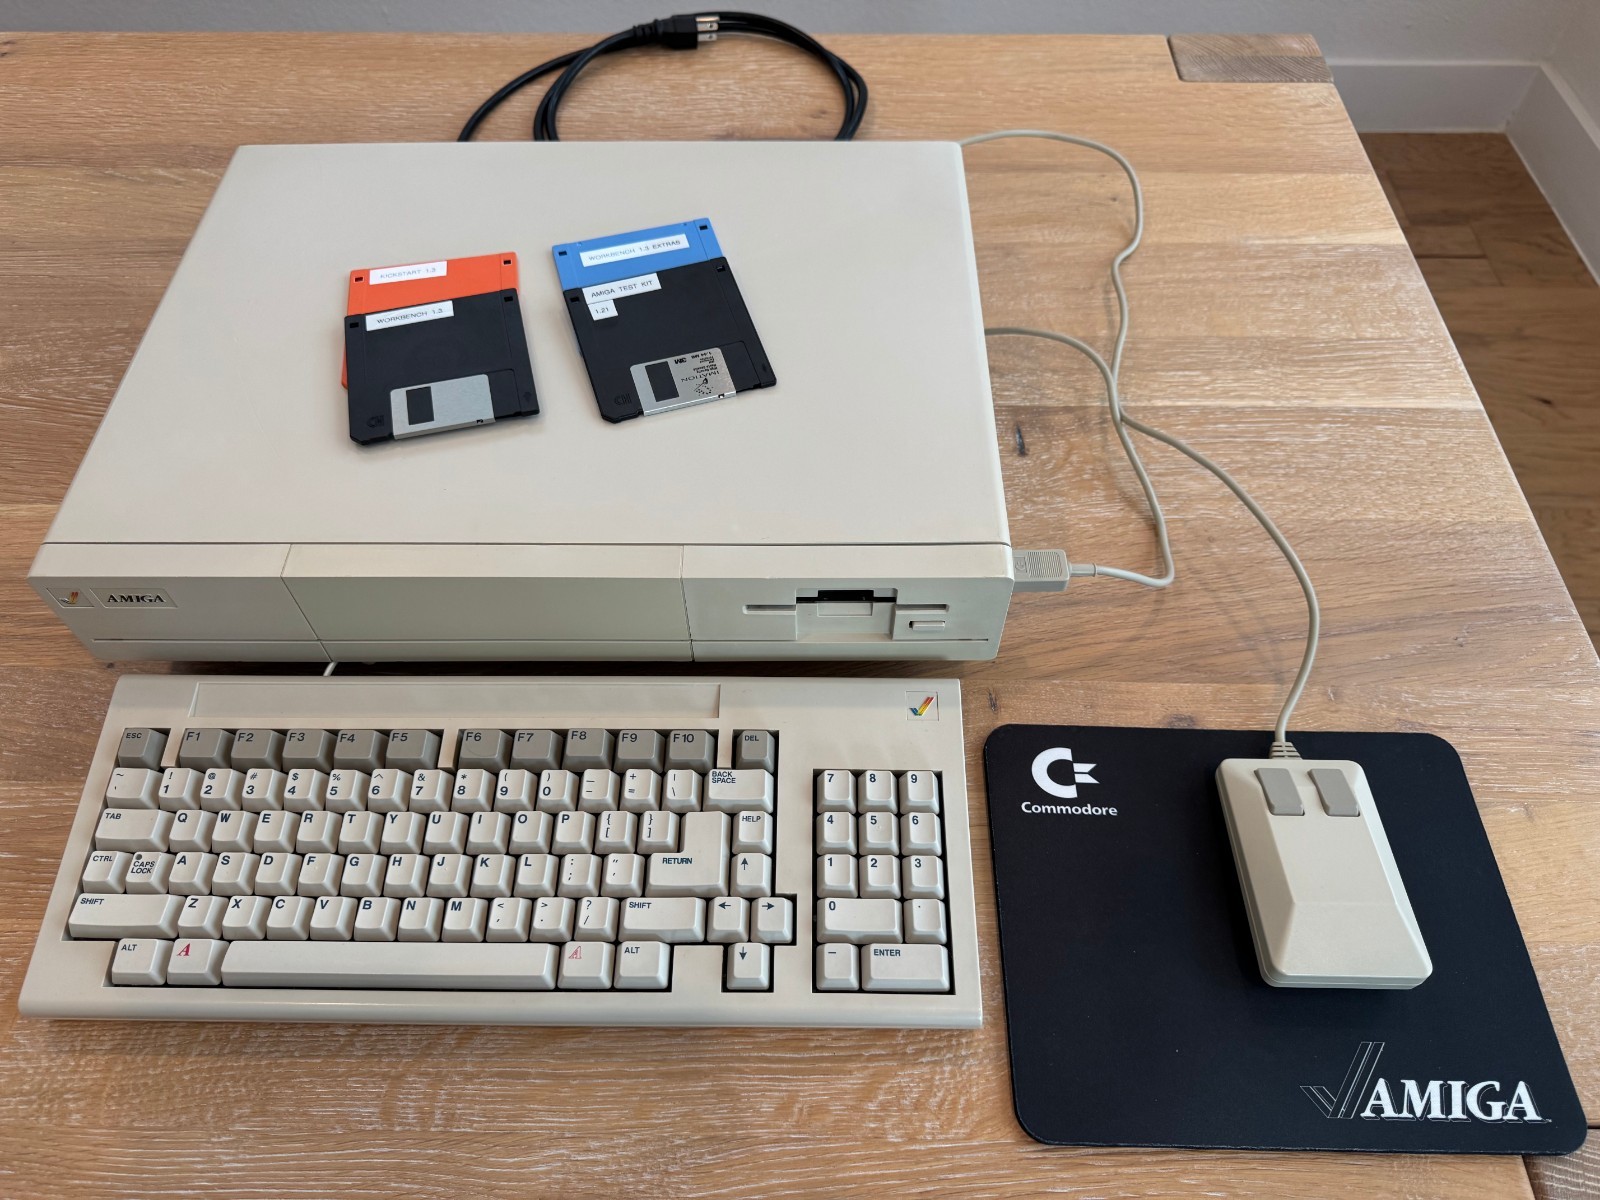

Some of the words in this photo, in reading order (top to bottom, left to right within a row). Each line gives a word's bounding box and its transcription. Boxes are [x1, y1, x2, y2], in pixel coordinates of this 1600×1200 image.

[588, 249, 635, 261] WORKBENCH
[652, 240, 681, 249] EXTRAS
[380, 269, 422, 279] KICKSTART
[591, 288, 616, 298] AMIGA
[618, 283, 637, 292] TEST
[376, 311, 428, 324] WORKBENCH
[680, 370, 719, 382] IMATION
[107, 594, 165, 603] AMIGA
[186, 731, 200, 741] F1
[237, 732, 254, 742] F2
[288, 732, 305, 742] F3
[339, 733, 355, 743] F4
[391, 732, 408, 742] F5
[466, 732, 482, 742] F6
[517, 733, 534, 742] F7
[571, 730, 587, 740] F8
[622, 733, 637, 743] F9
[673, 733, 694, 743] F10
[292, 773, 299, 781] $
[417, 773, 425, 781] &
[504, 773, 508, 782] (
[547, 773, 551, 782] )
[712, 771, 732, 779] BACK
[827, 773, 834, 782] 7
[869, 773, 876, 783] 8
[911, 774, 917, 783] 9
[164, 785, 169, 794] 1
[204, 785, 213, 795] 2
[246, 785, 255, 795] 3
[288, 786, 296, 795] 4
[330, 786, 338, 796] 5
[372, 785, 380, 795] 6
[416, 786, 424, 795] 7
[457, 785, 466, 795] 8
[500, 786, 508, 796] 9
[543, 786, 551, 796] 0
[1021, 801, 1118, 816] Commodore
[177, 813, 188, 823] Q
[221, 813, 231, 823] W
[262, 813, 271, 823] E
[304, 813, 313, 823] R
[348, 814, 356, 823] T
[390, 814, 398, 824] Y
[432, 814, 441, 824] U
[478, 814, 482, 824] I
[518, 814, 528, 824] O
[561, 814, 570, 823] P
[607, 813, 611, 825] {
[648, 814, 653, 825] }
[827, 815, 834, 824] 4
[870, 815, 877, 825] 5
[912, 815, 919, 825] 6
[605, 827, 610, 838] [
[648, 827, 652, 838] ]
[177, 855, 186, 865] A
[221, 855, 230, 865] S
[263, 855, 273, 865] D
[307, 856, 316, 865] F
[349, 856, 359, 866] G
[392, 856, 402, 866] H
[437, 856, 445, 866] J
[480, 857, 490, 867] K
[524, 857, 532, 867] L
[828, 857, 832, 867] 1
[871, 858, 877, 868] 2
[915, 858, 921, 868] 3
[188, 898, 199, 908] Z
[231, 899, 242, 909] X
[275, 899, 285, 909] C
[320, 899, 329, 909] V
[362, 900, 372, 910] B
[406, 900, 416, 910] N
[451, 901, 462, 911] M
[587, 900, 592, 910] ?
[829, 901, 836, 911] 0
[583, 915, 590, 925] /
[874, 949, 901, 957] ENTER
[1360, 1077, 1546, 1123] AMIGA
